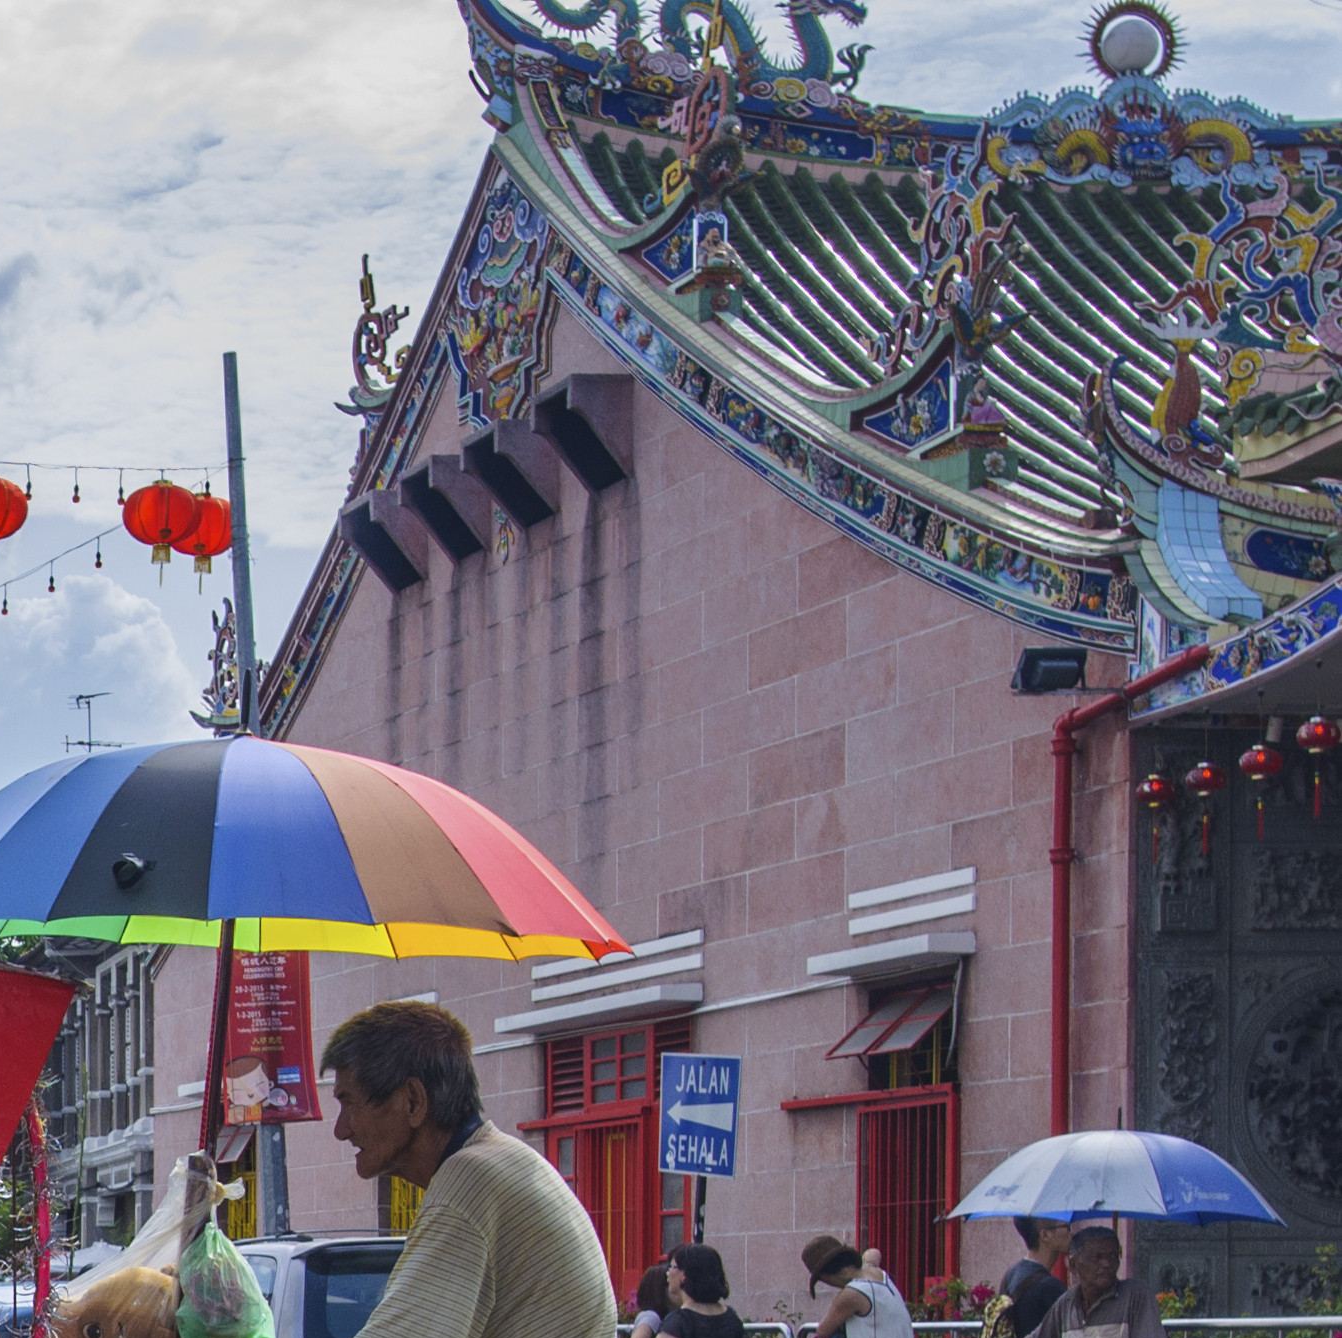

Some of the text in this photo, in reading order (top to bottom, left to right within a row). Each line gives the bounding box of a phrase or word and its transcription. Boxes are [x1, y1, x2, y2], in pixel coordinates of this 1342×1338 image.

[235, 985, 264, 994] 28-2-2015
[237, 1010, 262, 1018] 1-3-2015
[676, 1064, 730, 1095] JALAN
[666, 1133, 728, 1168] SEHALA
